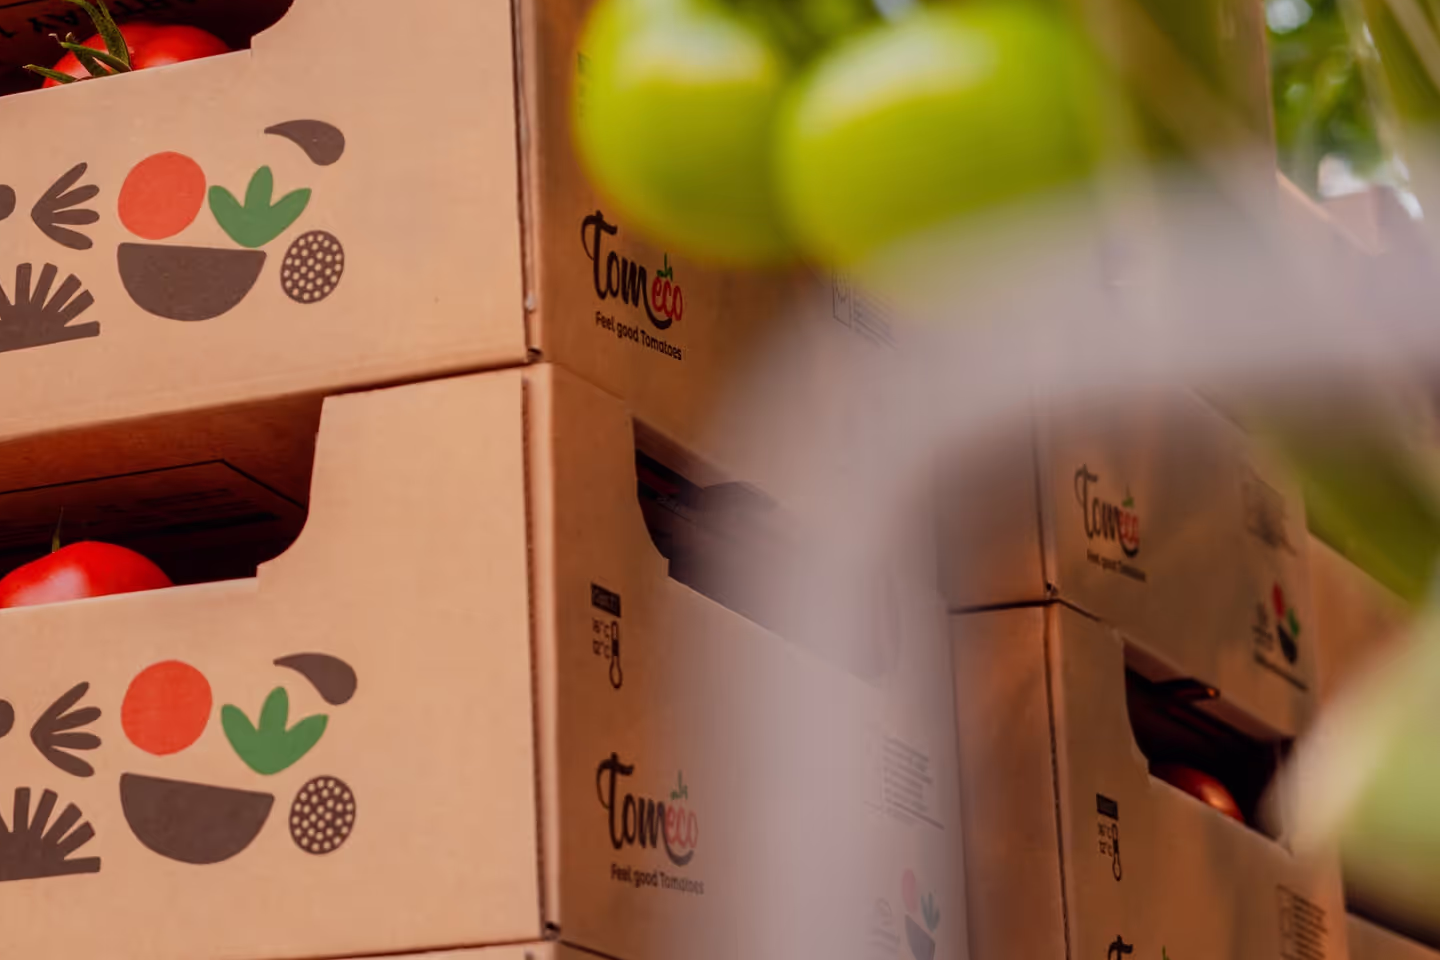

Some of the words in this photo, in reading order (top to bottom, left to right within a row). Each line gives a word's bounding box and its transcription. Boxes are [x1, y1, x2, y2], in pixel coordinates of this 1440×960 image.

[580, 209, 683, 331] Tomeco
[595, 311, 616, 333] Feel
[616, 321, 639, 342] good
[640, 329, 682, 361] Tomatoes
[596, 751, 699, 867] Tomeco
[633, 869, 658, 889] good
